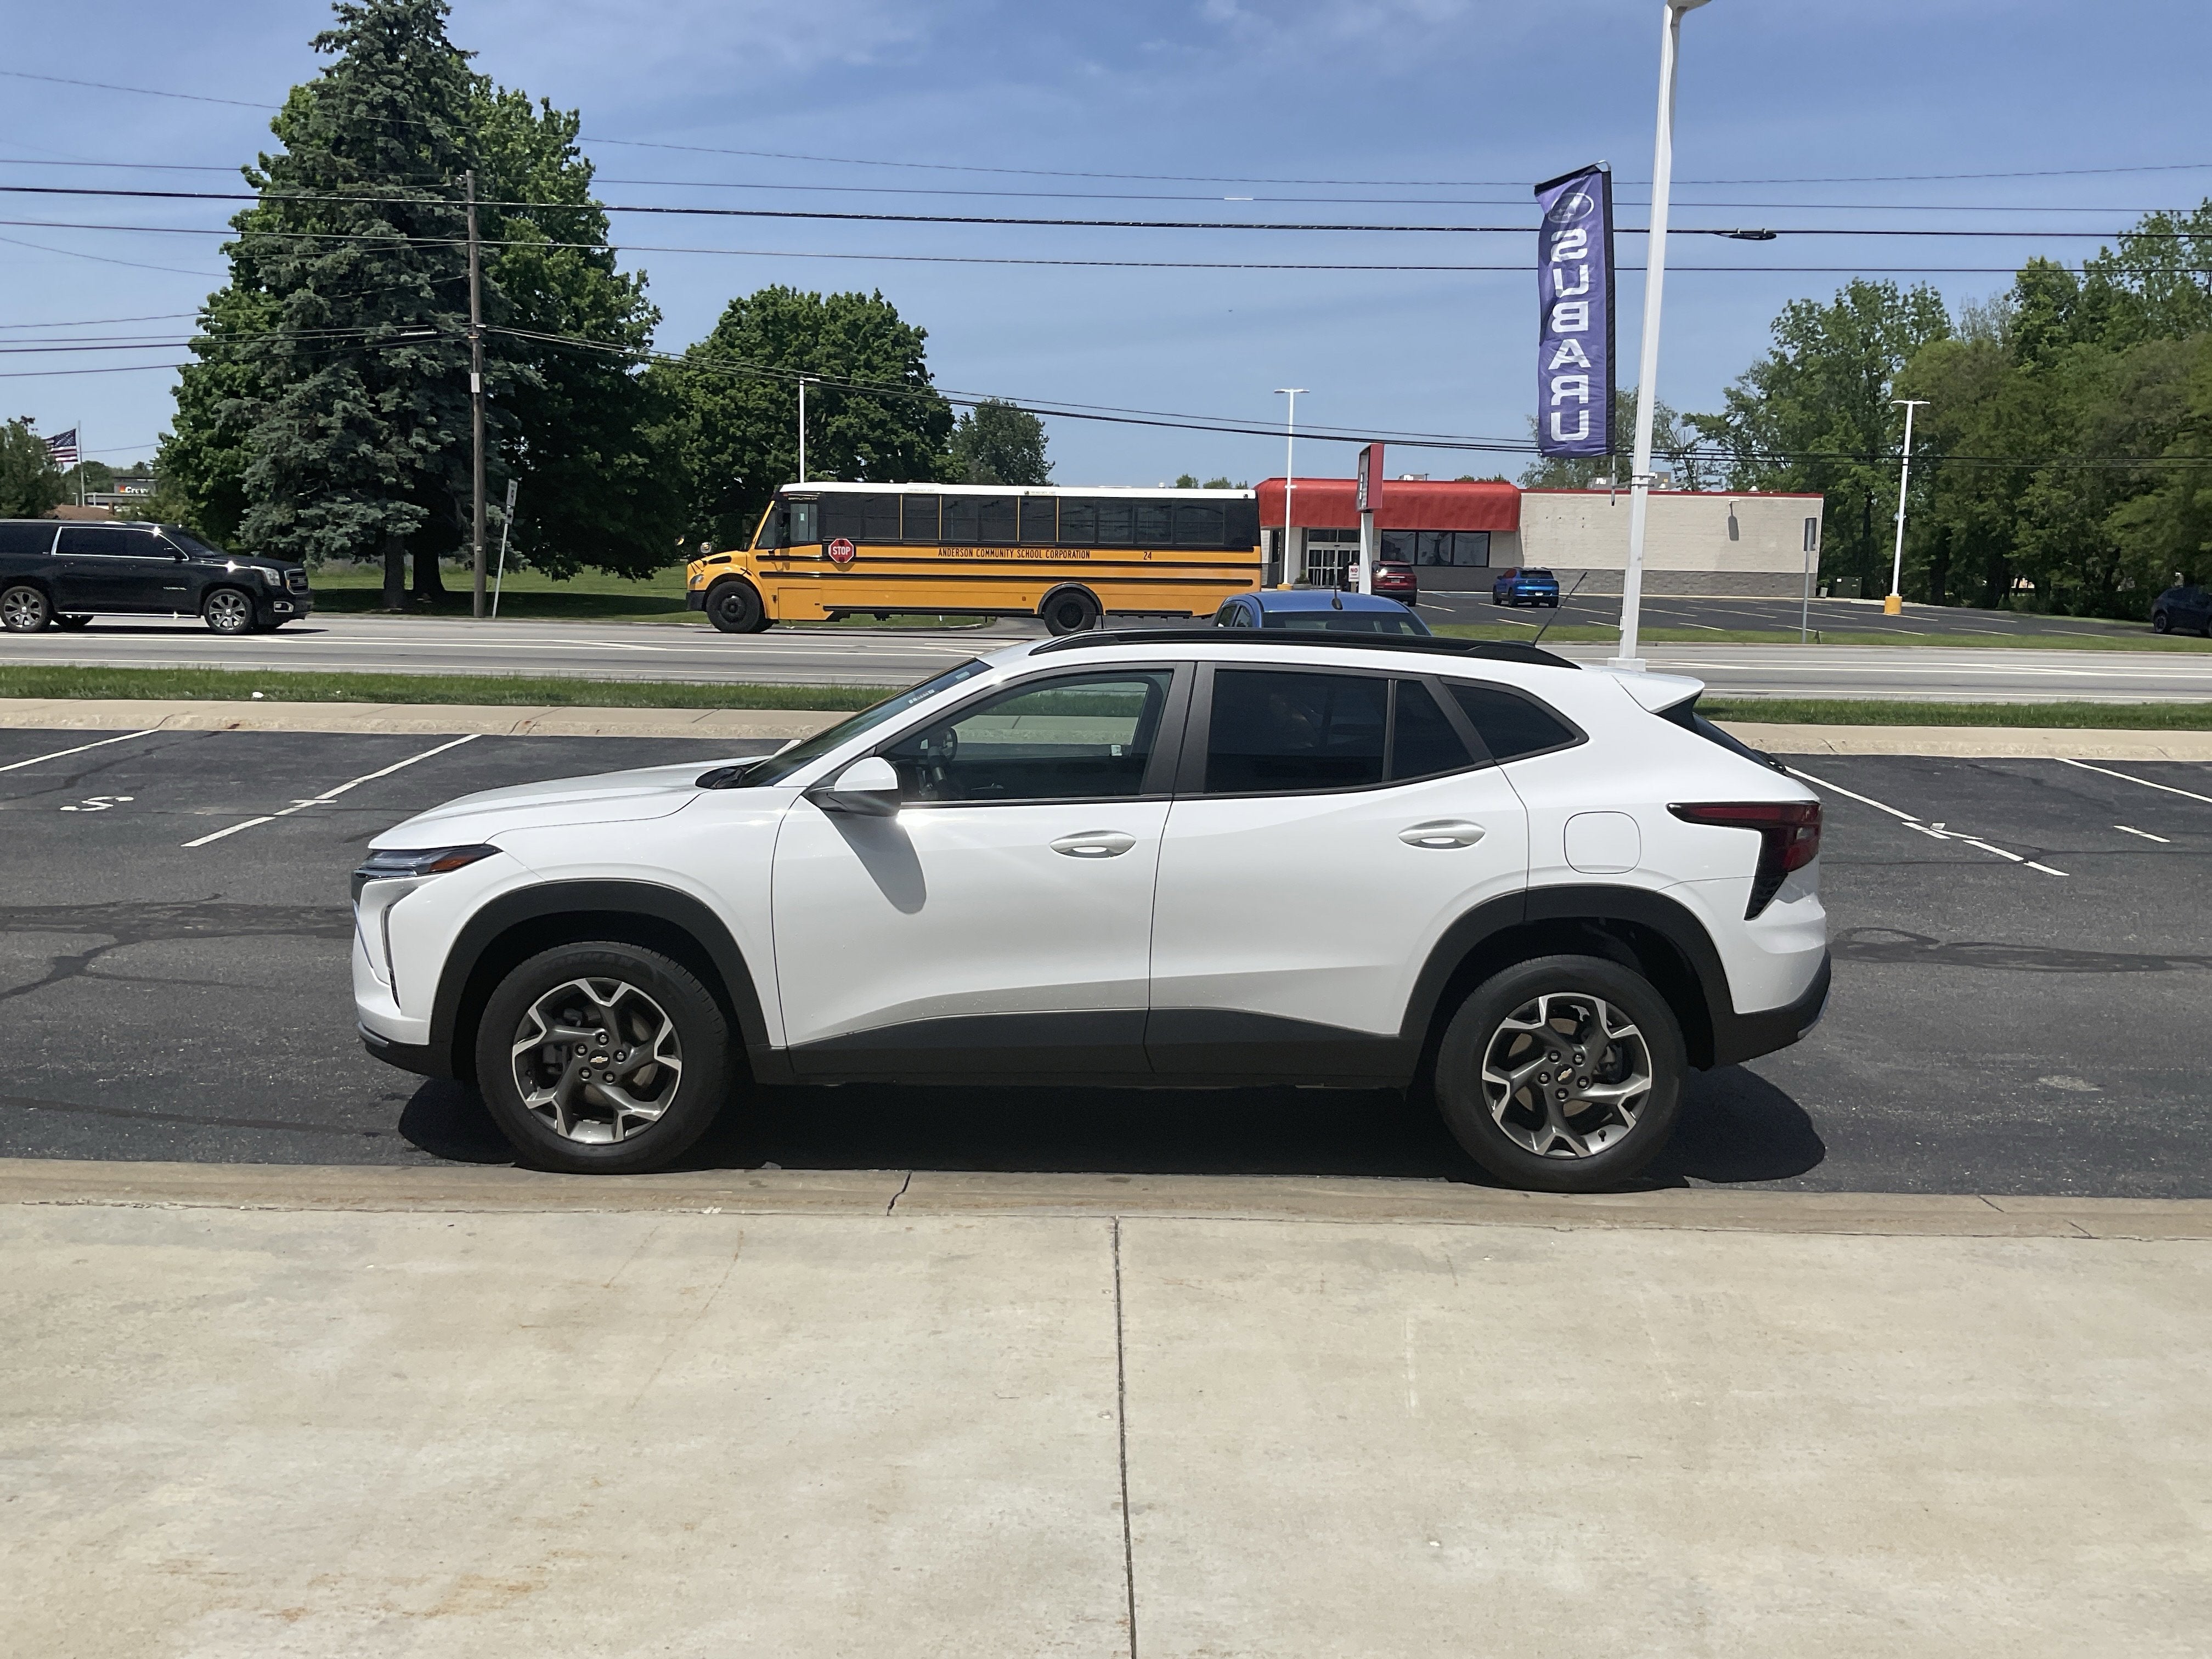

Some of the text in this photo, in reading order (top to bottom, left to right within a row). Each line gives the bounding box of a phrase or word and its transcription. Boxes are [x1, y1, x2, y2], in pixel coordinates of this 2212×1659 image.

[833, 546, 851, 556] STOP
[938, 548, 1090, 559] ANDERSON COMMUNITY SCHOOL CORPORATION
[1143, 551, 1152, 560] 24
